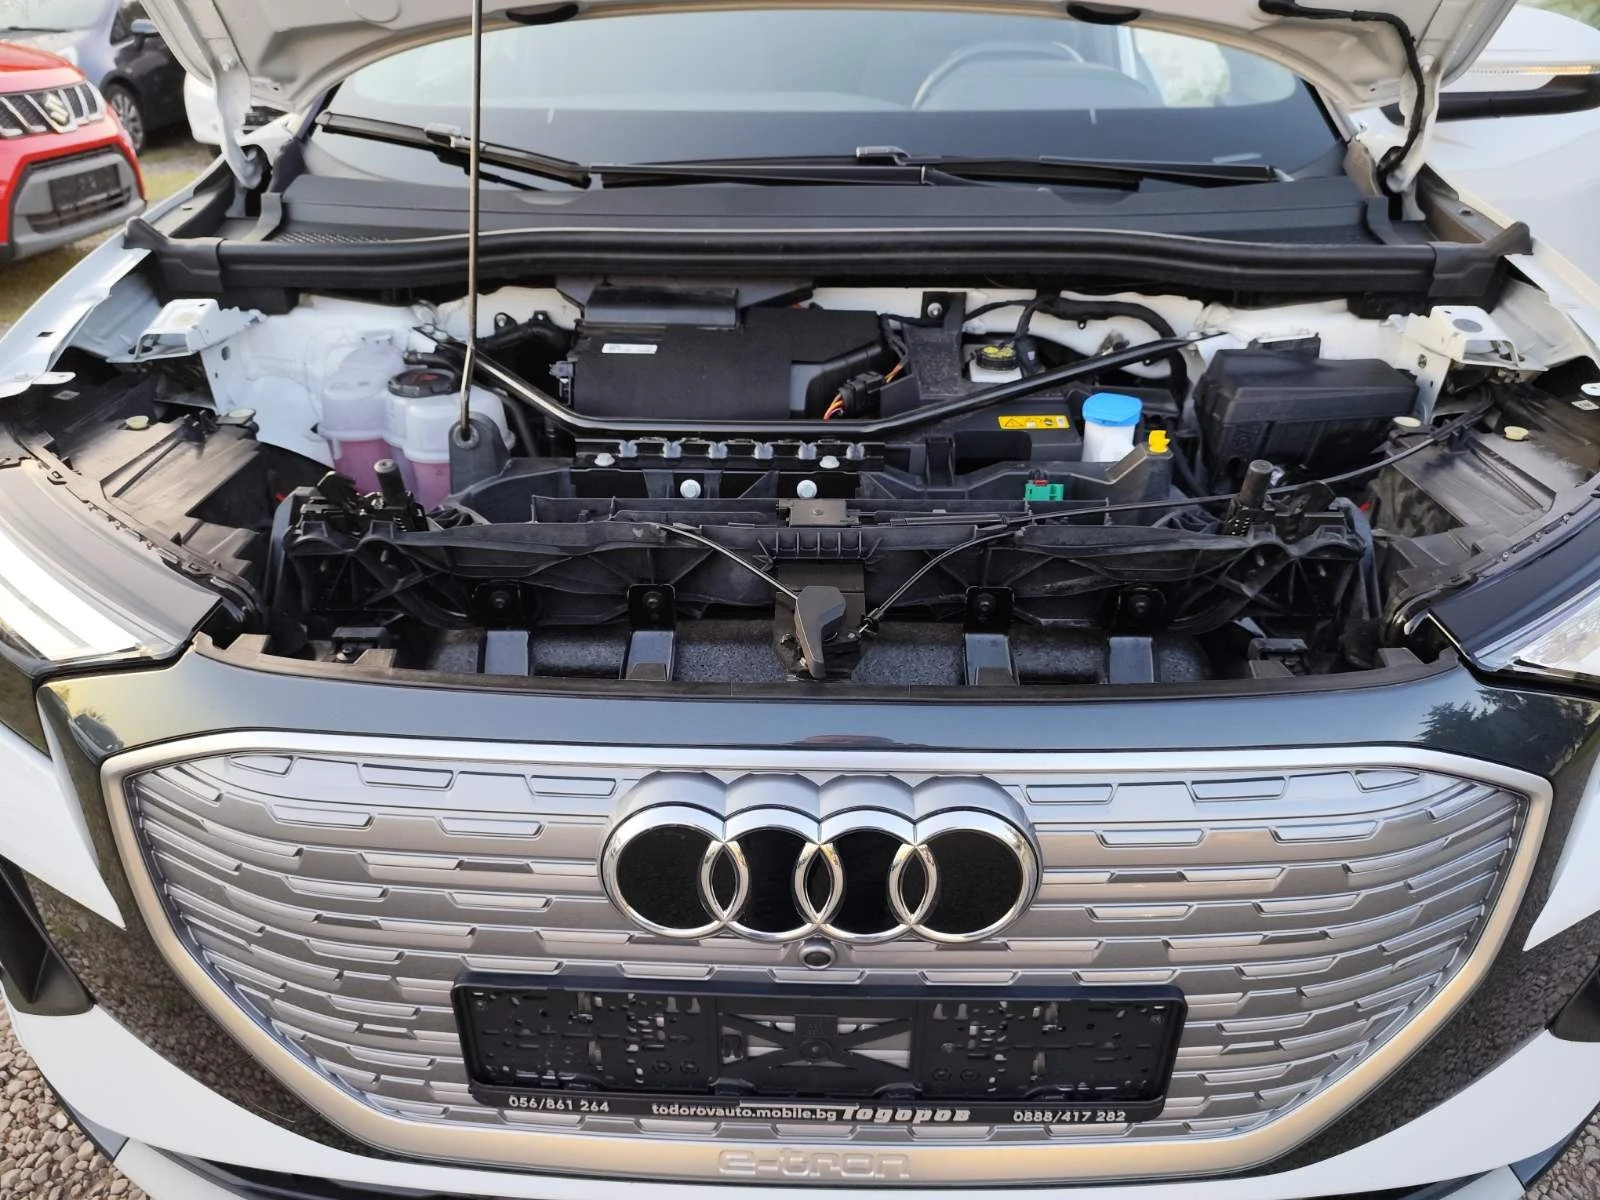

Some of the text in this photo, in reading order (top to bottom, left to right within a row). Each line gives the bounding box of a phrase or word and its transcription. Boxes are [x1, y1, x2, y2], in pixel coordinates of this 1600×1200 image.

[508, 1095, 610, 1112] 056/861 264
[651, 1103, 837, 1121] todorovauto.mobile.bg
[1013, 1109, 1127, 1123] 0888/417 282
[718, 1149, 910, 1178] e-tron
